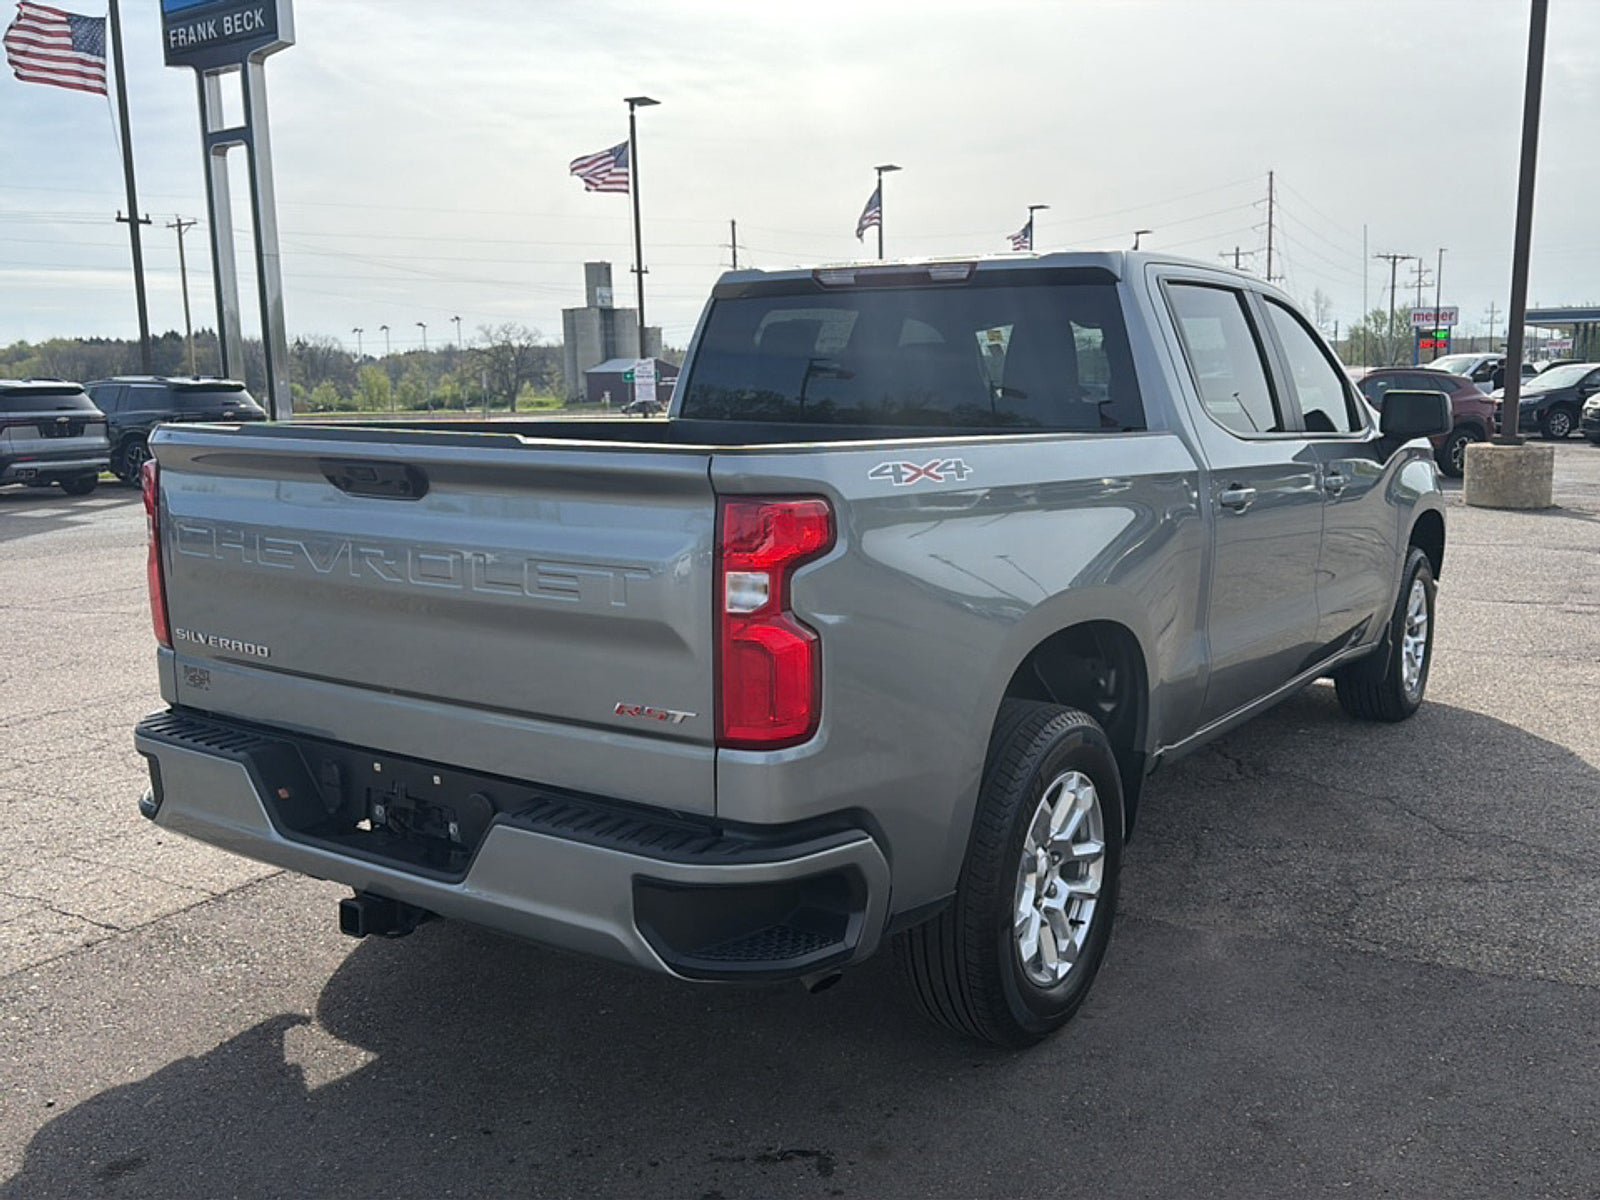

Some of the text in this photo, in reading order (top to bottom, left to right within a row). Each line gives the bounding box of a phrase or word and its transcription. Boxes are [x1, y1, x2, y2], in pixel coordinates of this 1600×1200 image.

[169, 8, 265, 49] FRANK BECK
[174, 520, 652, 607] CHEVROLET
[175, 627, 269, 658] SILVERADO
[614, 702, 697, 724] RST
